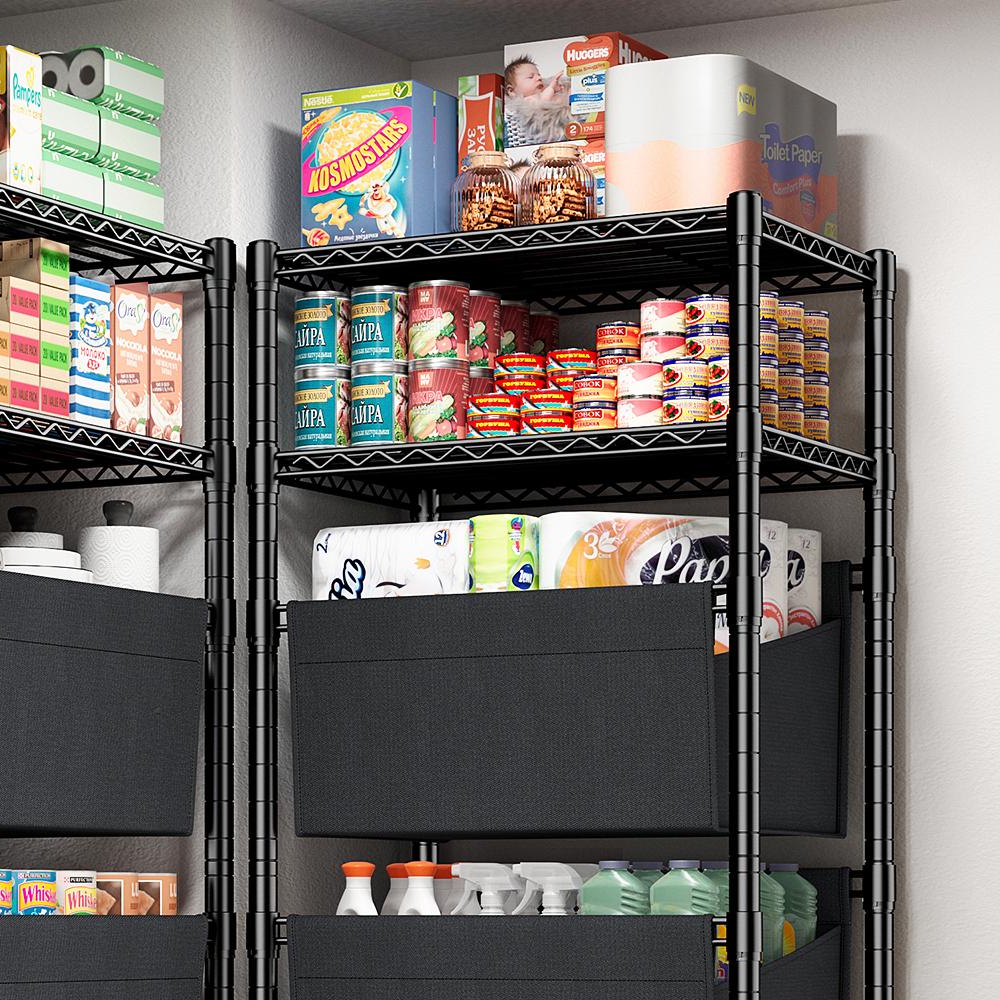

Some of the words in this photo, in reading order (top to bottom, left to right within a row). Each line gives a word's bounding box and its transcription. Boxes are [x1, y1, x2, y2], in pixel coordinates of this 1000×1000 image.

[567, 48, 609, 62] HUGGERS
[12, 72, 41, 107] Pampers
[582, 75, 598, 86] plus
[570, 125, 577, 134] 2
[308, 114, 408, 194] KOSMOSTARS
[760, 134, 791, 161] Toilet
[792, 144, 823, 166] Paper
[80, 346, 106, 361] МОЛОКО
[584, 532, 598, 560] 3
